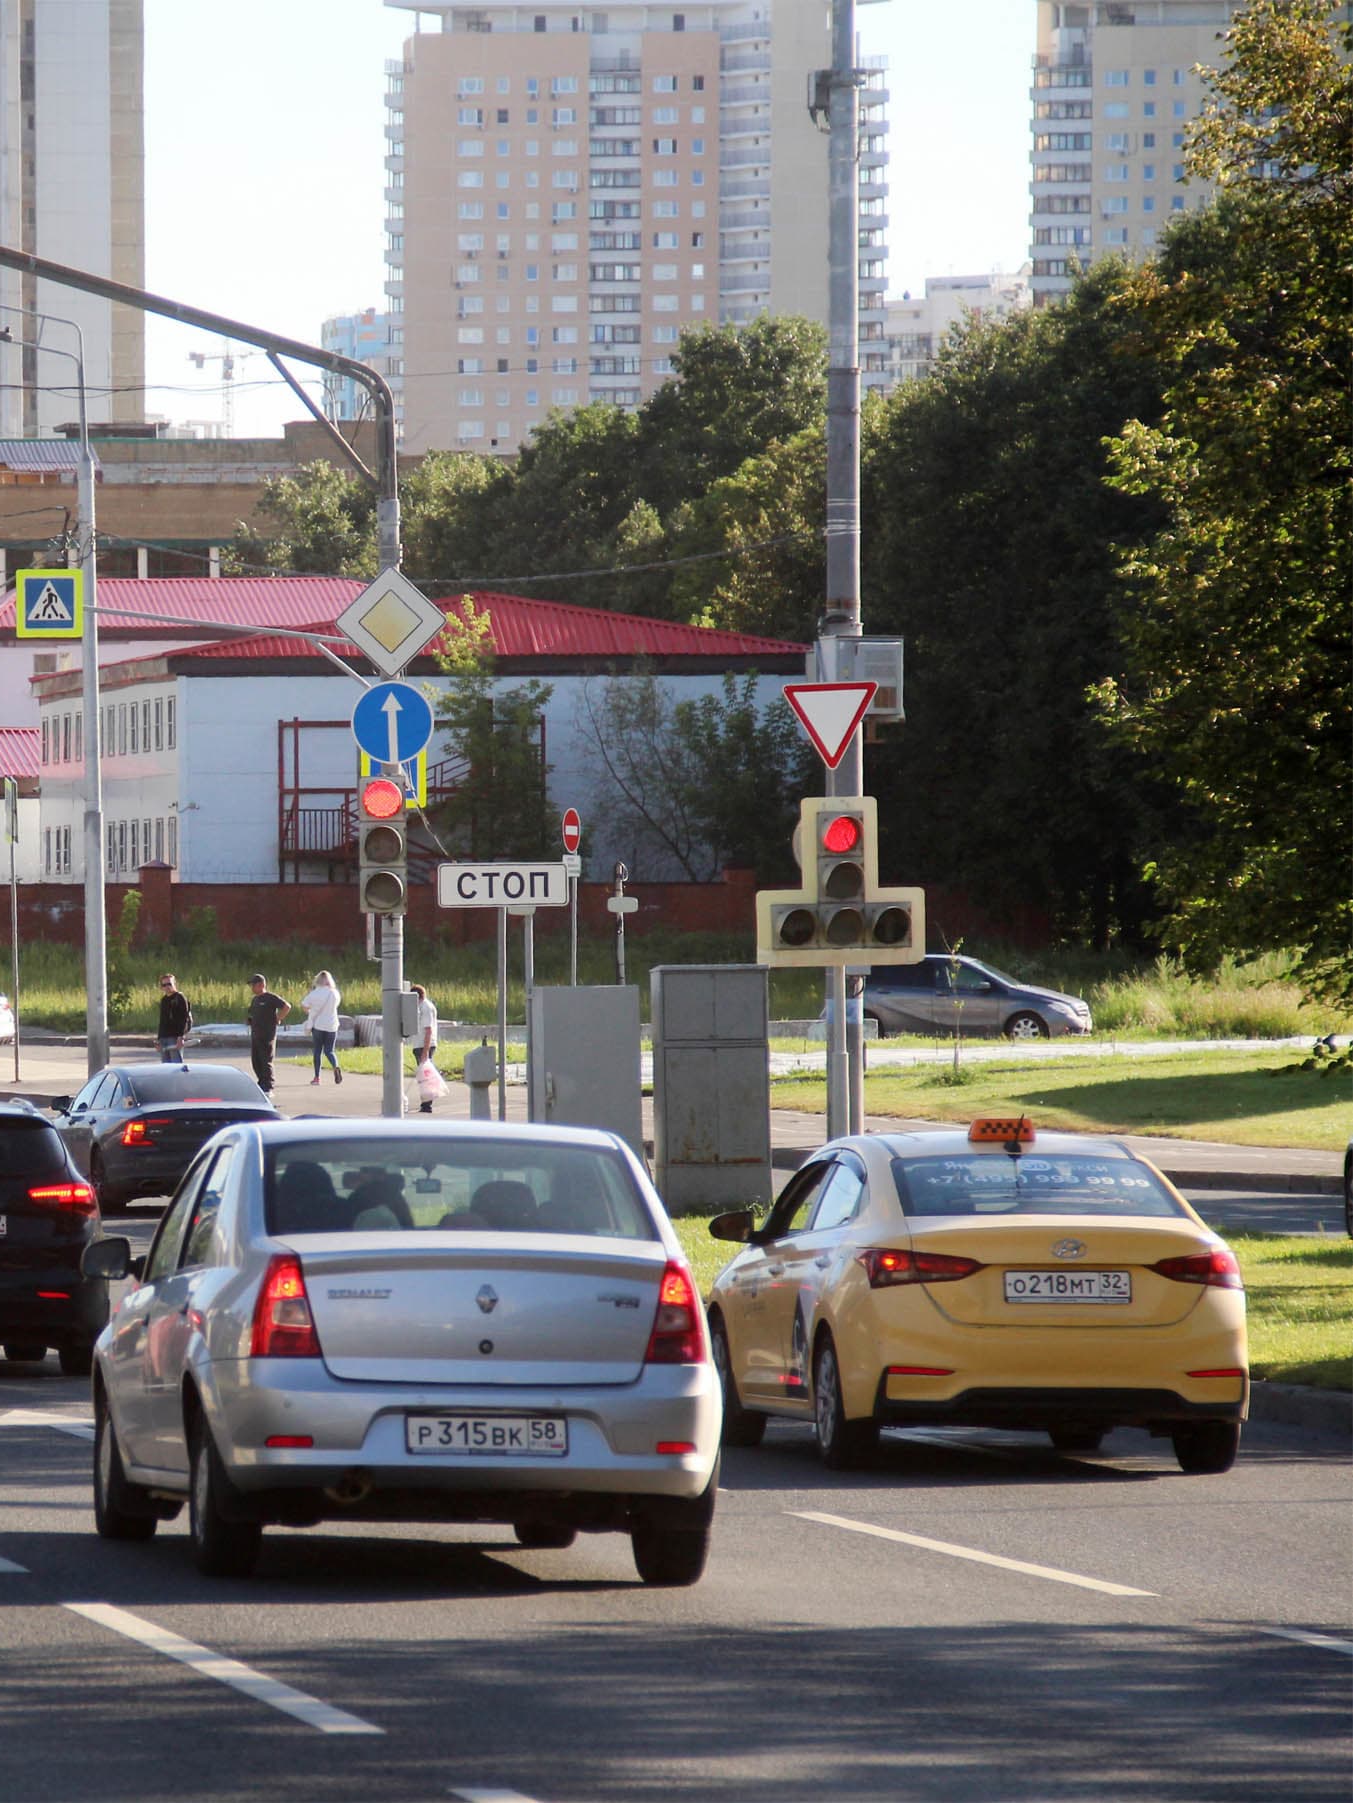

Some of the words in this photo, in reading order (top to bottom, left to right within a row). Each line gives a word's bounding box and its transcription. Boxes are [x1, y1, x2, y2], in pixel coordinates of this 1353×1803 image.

[457, 871, 549, 899] СТОП
[1086, 1175, 1115, 1185] 99
[1120, 1177, 1151, 1188] 99
[1101, 1273, 1122, 1289] 32
[531, 1421, 557, 1440] 58
